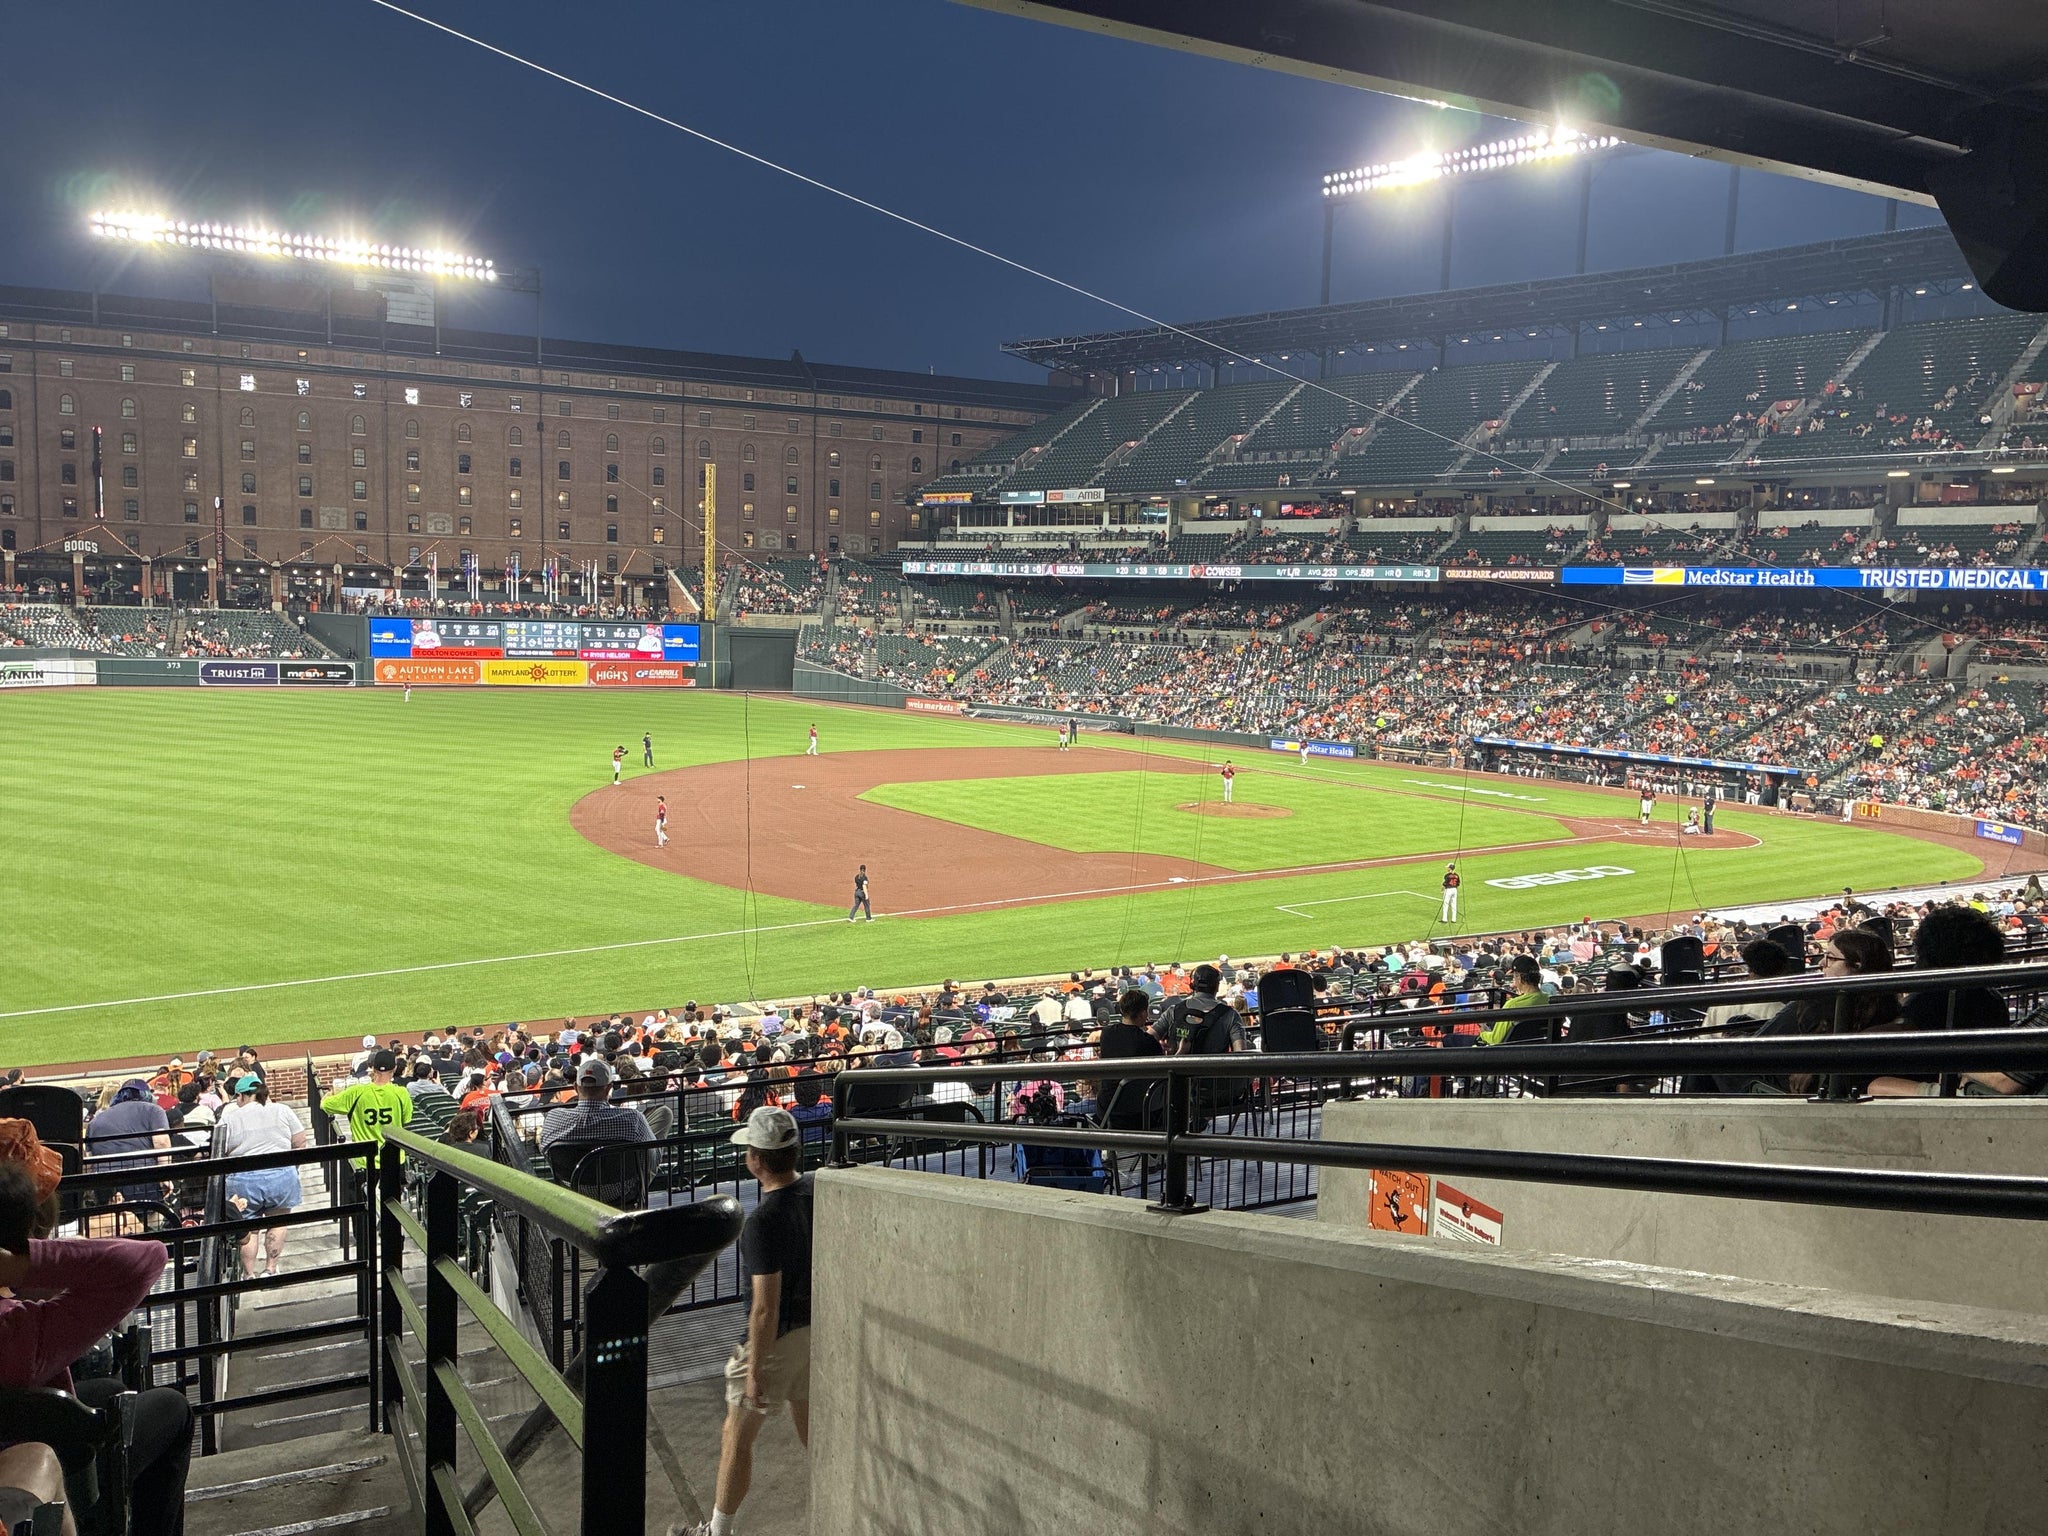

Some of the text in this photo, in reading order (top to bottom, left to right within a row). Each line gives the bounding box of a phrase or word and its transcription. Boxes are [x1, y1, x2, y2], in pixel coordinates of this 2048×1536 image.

[64, 540, 98, 554] BOOGS
[1056, 566, 1084, 575] NELSON
[1206, 567, 1242, 576] COWSER
[1446, 570, 1471, 578] ORIOLE
[1472, 570, 1491, 578] PARK
[1499, 570, 1530, 579] CAMDEN
[1530, 571, 1554, 580] YARDS
[1688, 570, 1815, 586] MedStar Health
[1860, 570, 1944, 587] TRUSTED
[1948, 570, 2034, 588] MEDICAL
[211, 670, 247, 678] TRUIST
[596, 671, 628, 682] HIGH'S
[924, 703, 954, 711] markets
[1308, 744, 1354, 756] edStar Health
[1484, 866, 1635, 889] GEICO
[364, 1108, 393, 1126] 35
[1405, 1181, 1419, 1193] OUT
[1440, 1208, 1459, 1224] Welcome
[1460, 1219, 1465, 1228] to
